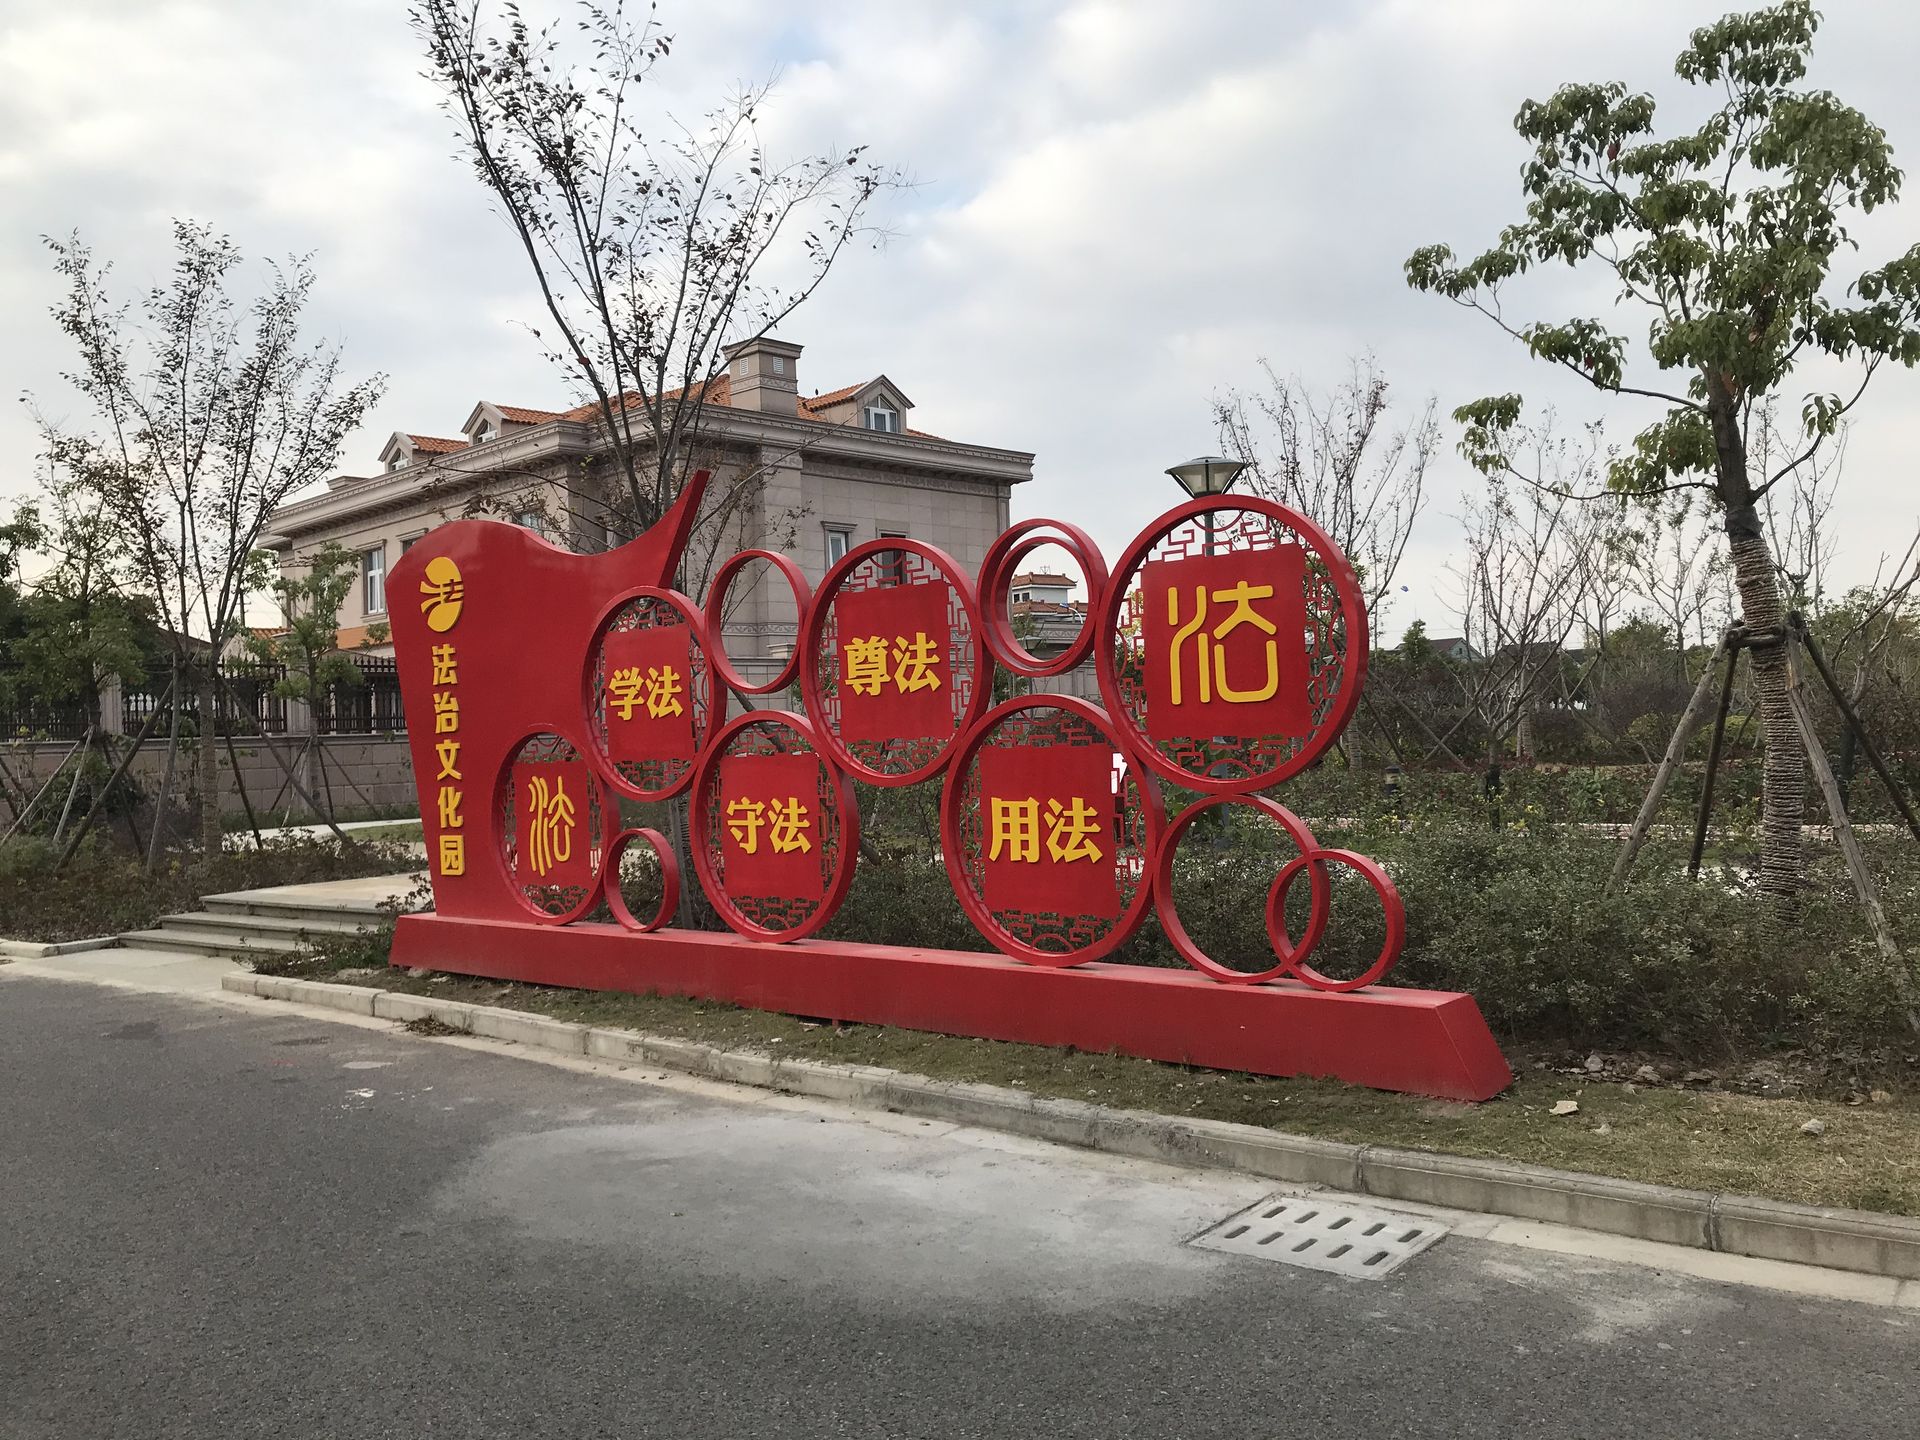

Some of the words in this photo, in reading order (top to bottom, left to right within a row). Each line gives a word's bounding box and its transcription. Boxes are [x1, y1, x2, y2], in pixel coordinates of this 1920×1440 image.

[608, 666, 684, 720] 学法
[844, 633, 941, 695] 尊法
[431, 644, 464, 876] 法治文化园
[726, 796, 812, 854] 守法
[988, 797, 1104, 863] 用法
